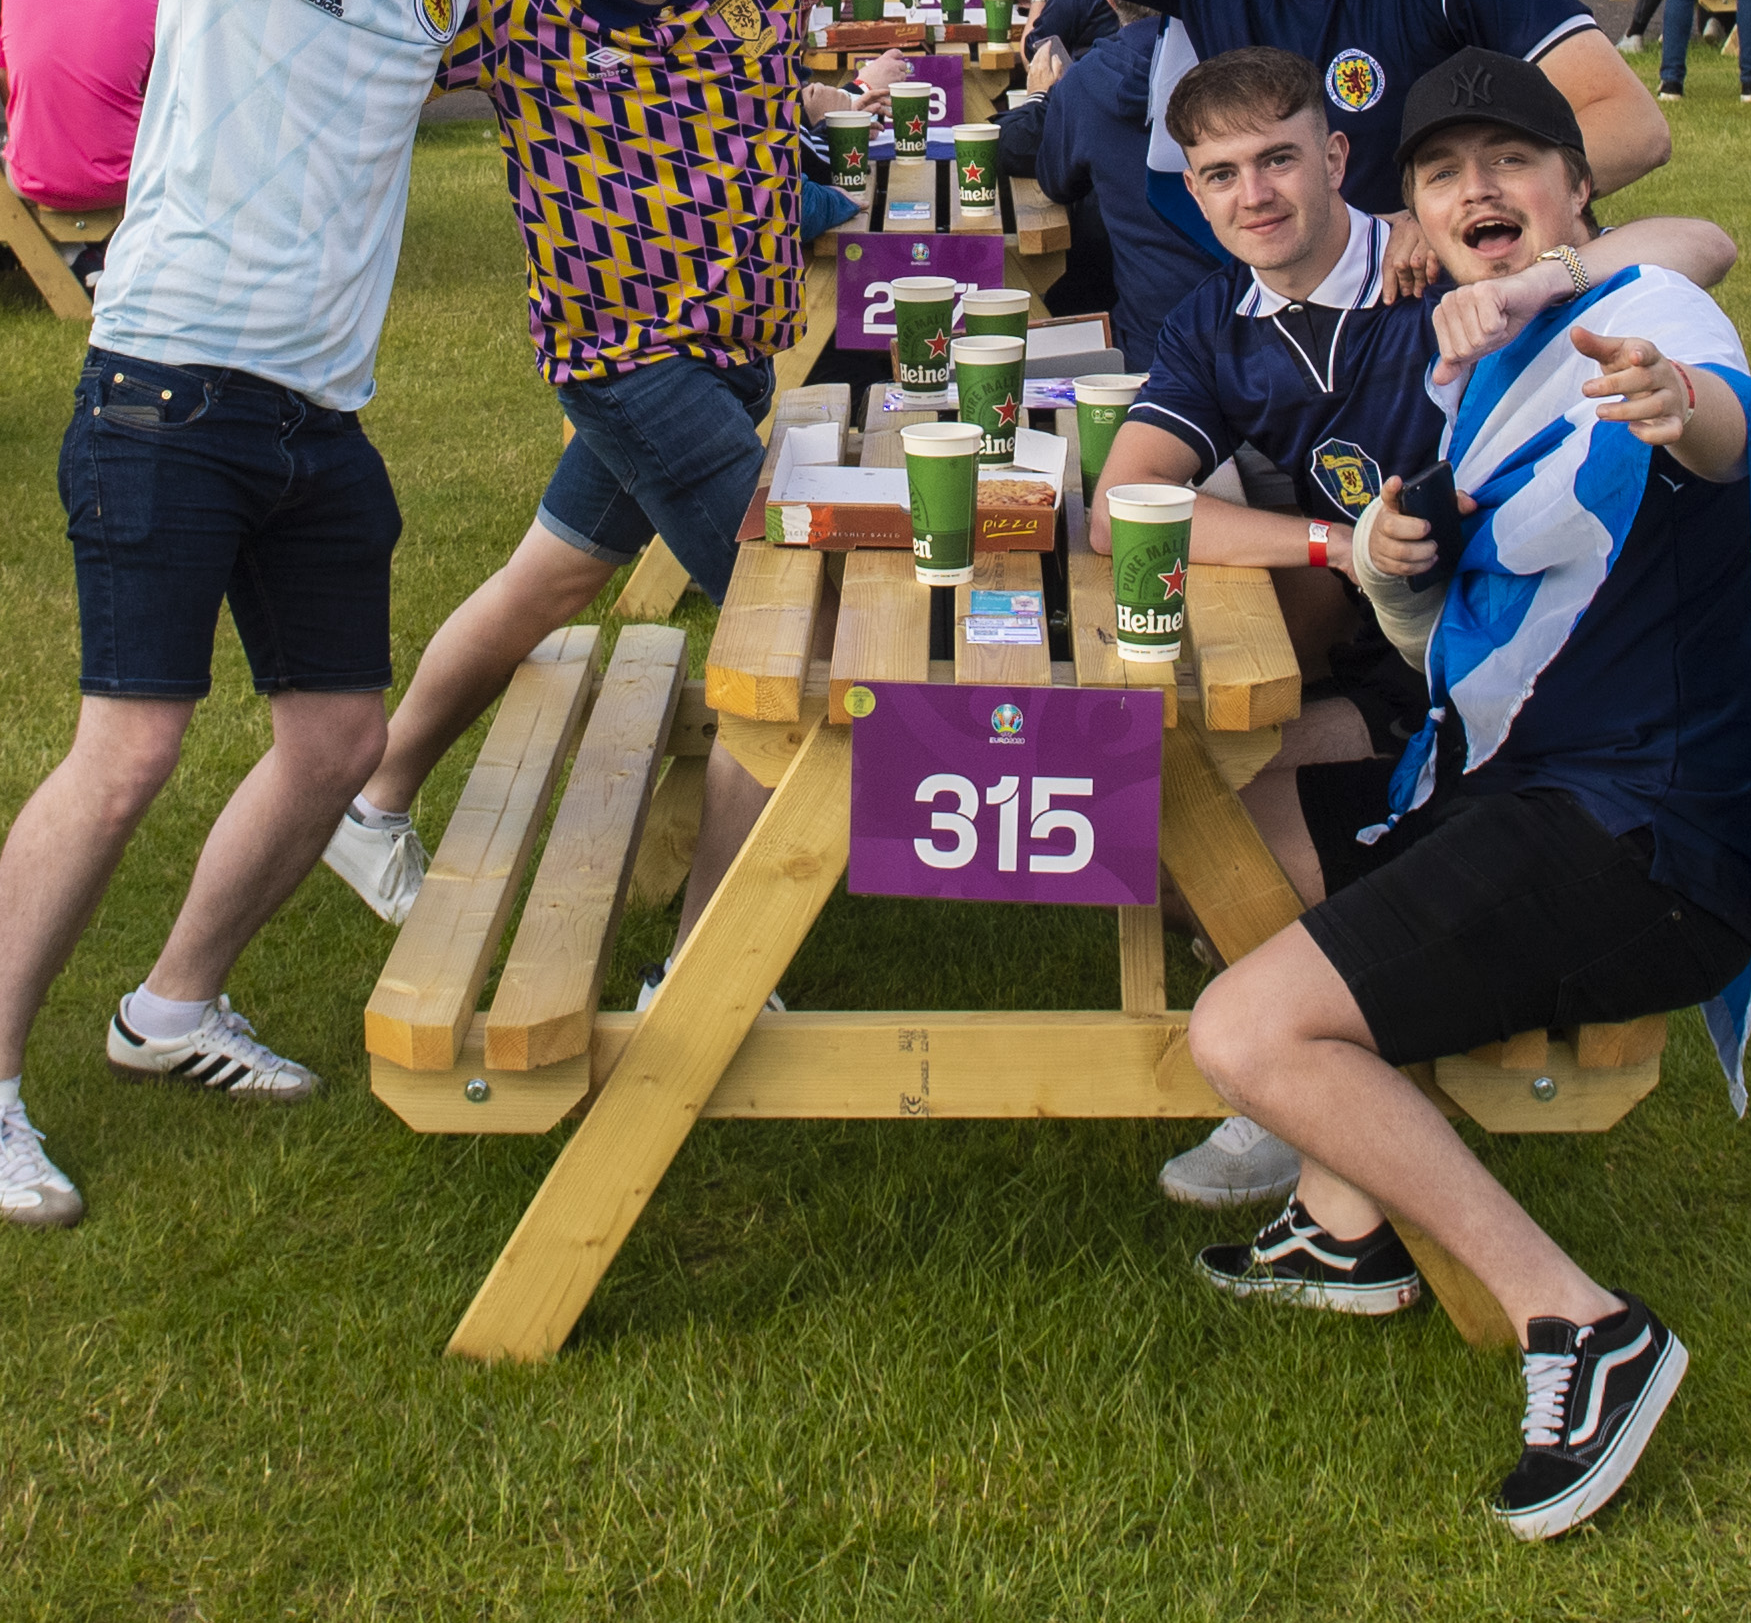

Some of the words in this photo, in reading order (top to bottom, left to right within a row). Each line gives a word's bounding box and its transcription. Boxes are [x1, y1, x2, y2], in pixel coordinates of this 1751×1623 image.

[588, 68, 629, 80] umbro
[983, 514, 1039, 533] pizza
[1123, 554, 1147, 593] PURE
[913, 772, 1096, 874] 315
